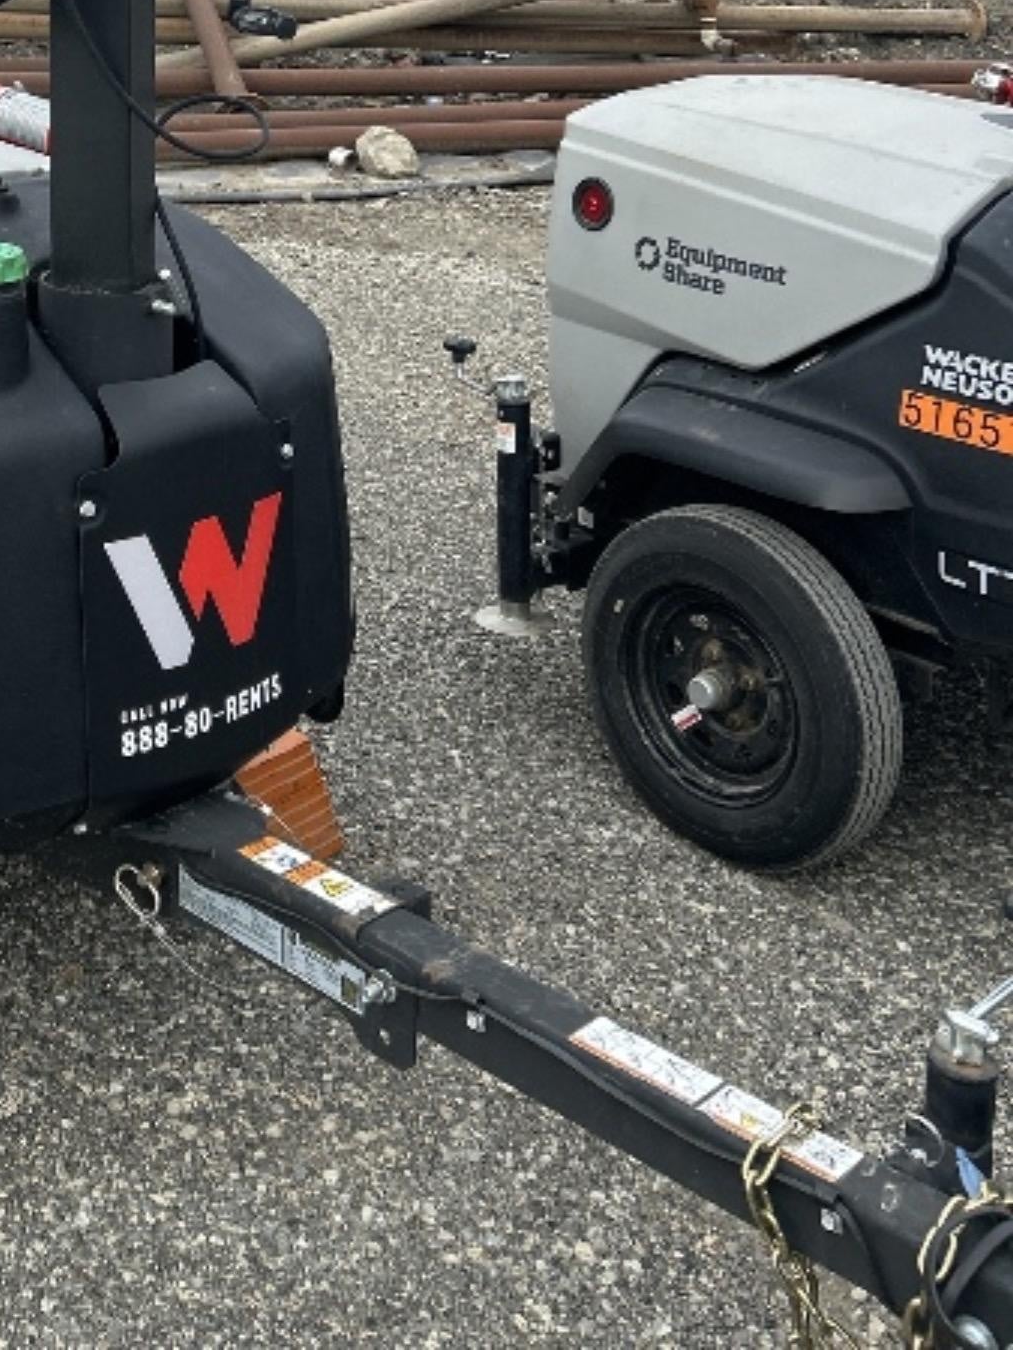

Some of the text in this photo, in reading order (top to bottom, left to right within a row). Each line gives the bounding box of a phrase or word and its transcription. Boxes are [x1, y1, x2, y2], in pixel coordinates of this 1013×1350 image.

[662, 260, 726, 295] Share
[665, 236, 787, 286] Equipment
[904, 392, 1013, 449] 5165
[120, 672, 282, 758] 888-80-RENTS
